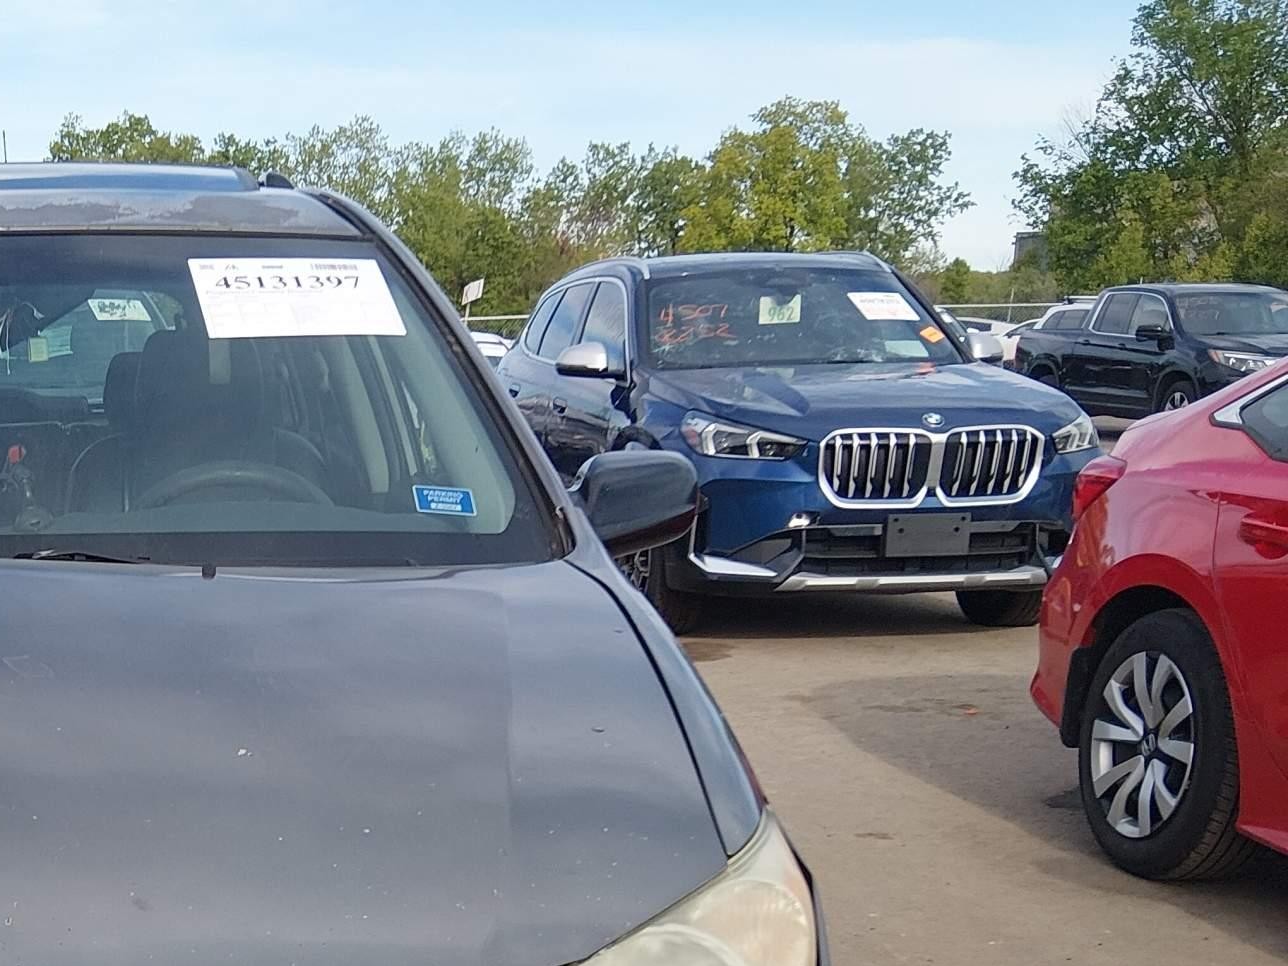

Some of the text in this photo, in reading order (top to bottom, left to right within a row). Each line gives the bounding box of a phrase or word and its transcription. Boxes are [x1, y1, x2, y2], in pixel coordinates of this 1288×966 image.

[215, 275, 360, 290] 45131397
[767, 304, 795, 322] 962
[422, 489, 464, 499] PARKING
[427, 495, 462, 504] PERMIT
